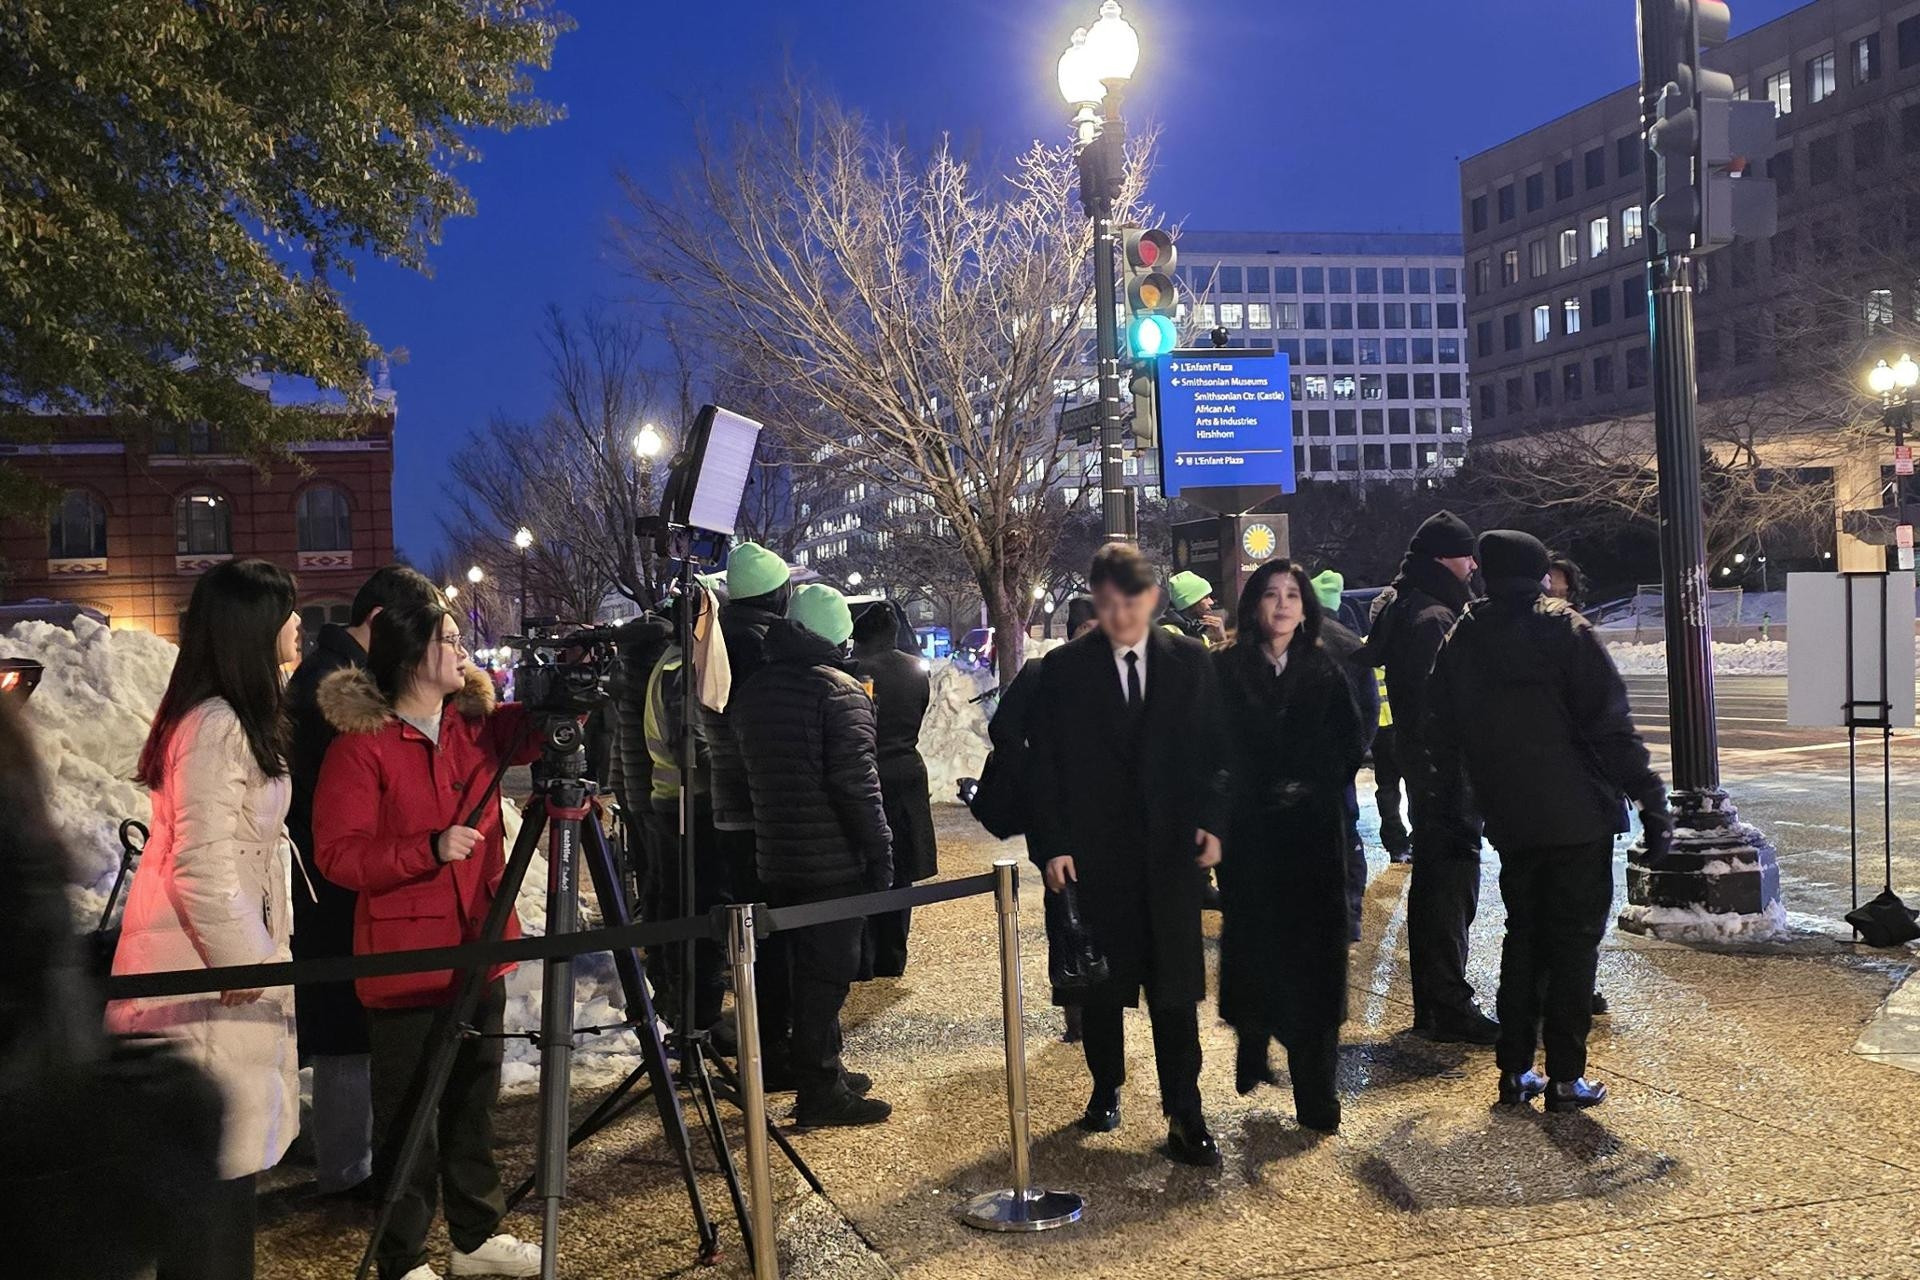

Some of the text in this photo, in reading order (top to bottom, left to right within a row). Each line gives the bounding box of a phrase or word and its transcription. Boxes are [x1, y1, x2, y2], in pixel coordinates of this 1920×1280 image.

[1181, 363, 1232, 371] L'Enfant Plaza
[1182, 378, 1268, 386] Smithsonian Museums
[1195, 391, 1285, 400] Smithsonian Ctr. (Castle)
[1195, 405, 1222, 413] African
[1220, 417, 1257, 425] Industries
[1197, 430, 1234, 438] Hirshhorn
[1195, 457, 1224, 465] L'Enfant
[1225, 456, 1244, 464] Plaza
